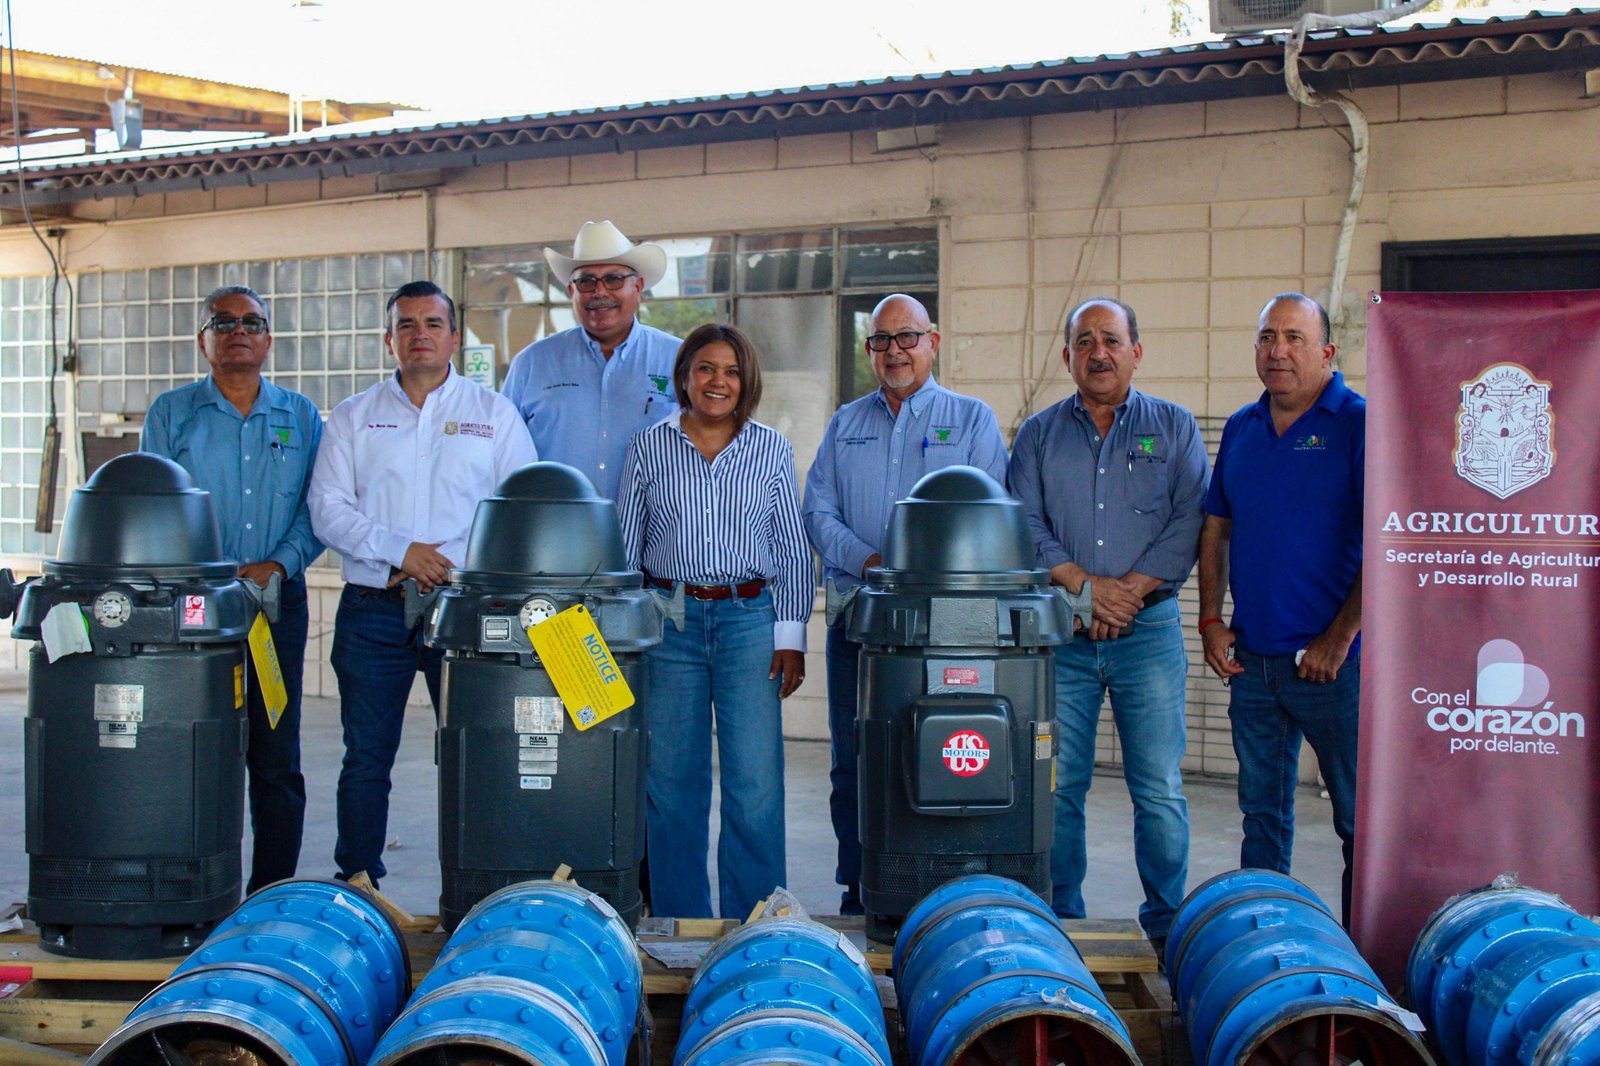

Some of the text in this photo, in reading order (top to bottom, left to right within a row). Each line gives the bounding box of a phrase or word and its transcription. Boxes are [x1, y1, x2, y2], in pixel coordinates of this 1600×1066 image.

[1382, 511, 1600, 536] AGRICULTUR
[1386, 549, 1600, 569] Secretaría de Agricultur
[1418, 571, 1578, 587] y Desarrollo Rural
[584, 633, 619, 685] NOTICE
[1411, 687, 1470, 706] Con el
[1427, 701, 1585, 738] corazón
[944, 749, 989, 758] MOTORS
[1450, 735, 1560, 755] por delante.
